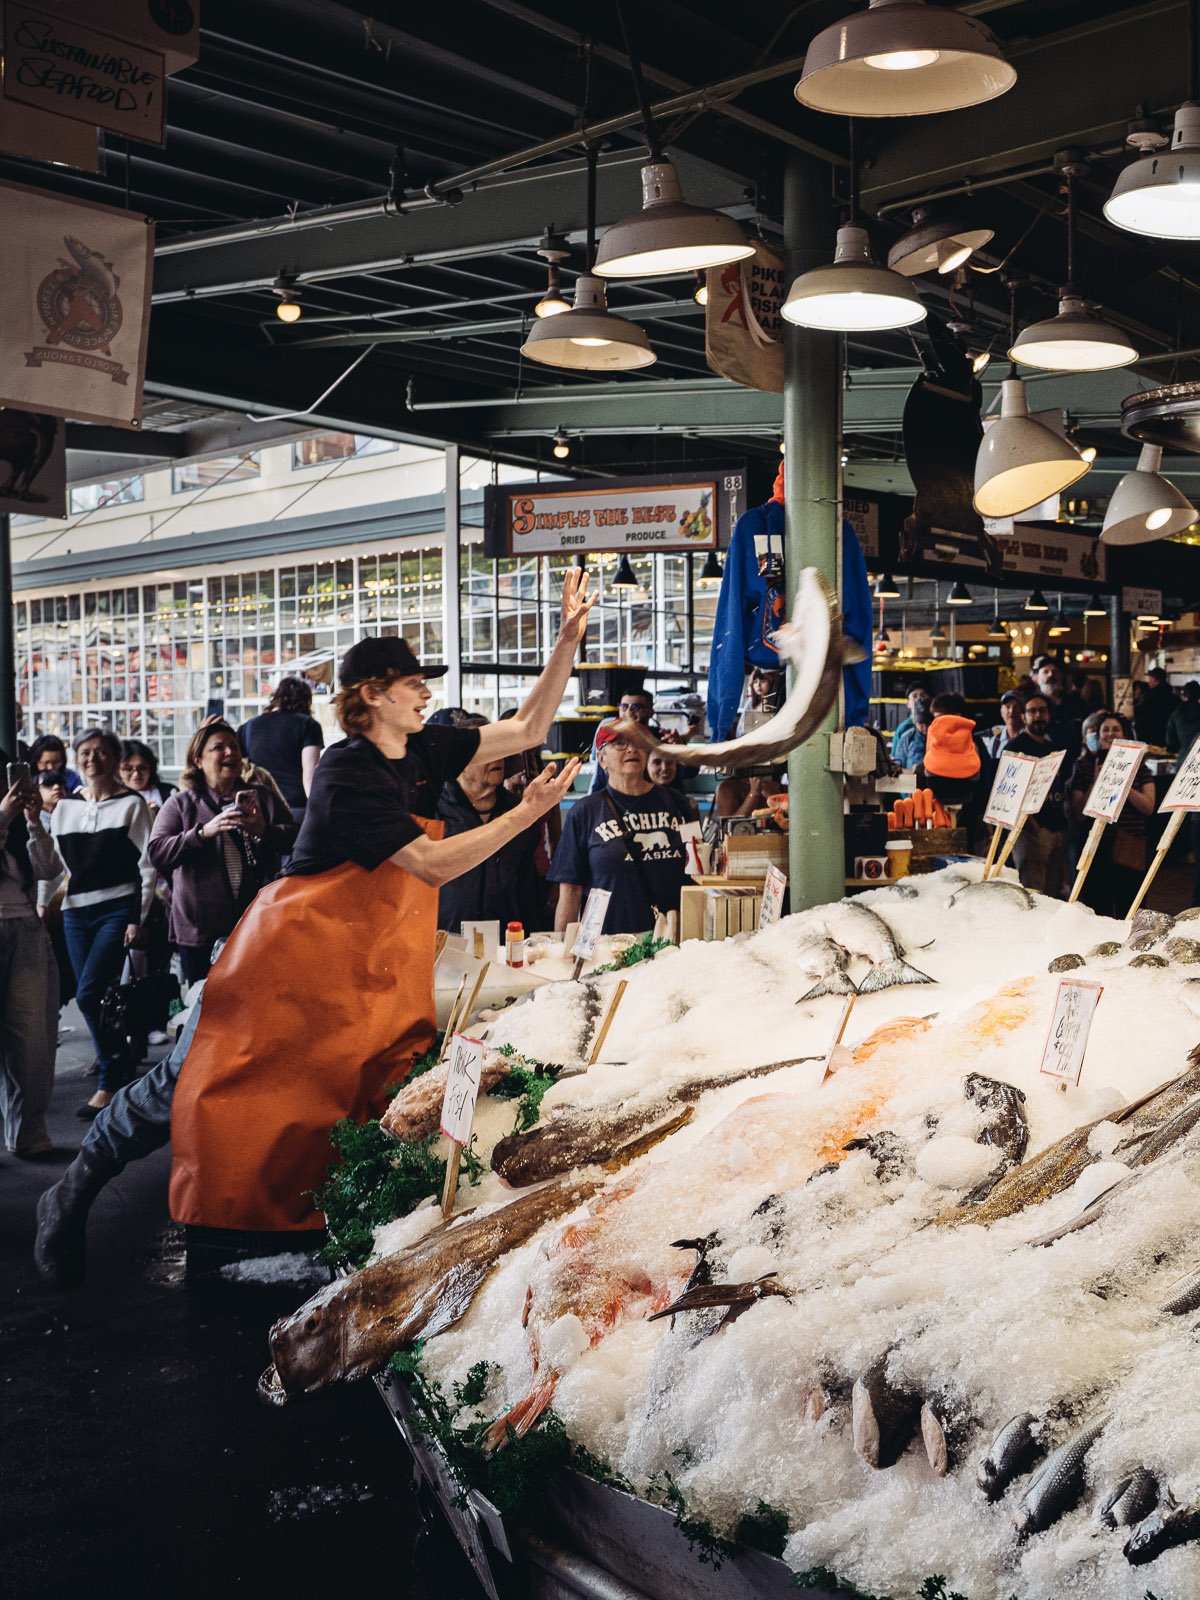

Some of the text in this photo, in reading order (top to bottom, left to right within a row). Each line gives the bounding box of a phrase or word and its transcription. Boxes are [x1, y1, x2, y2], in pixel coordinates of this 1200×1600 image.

[15, 20, 161, 85] SUSTAINABLE
[752, 265, 784, 284] PIKE
[726, 476, 741, 489] 88
[843, 499, 869, 513] RIED
[513, 498, 676, 534] SIMPLY THE BEST
[561, 530, 666, 546] DRIED PRODUCE
[624, 849, 682, 862] AASKA
